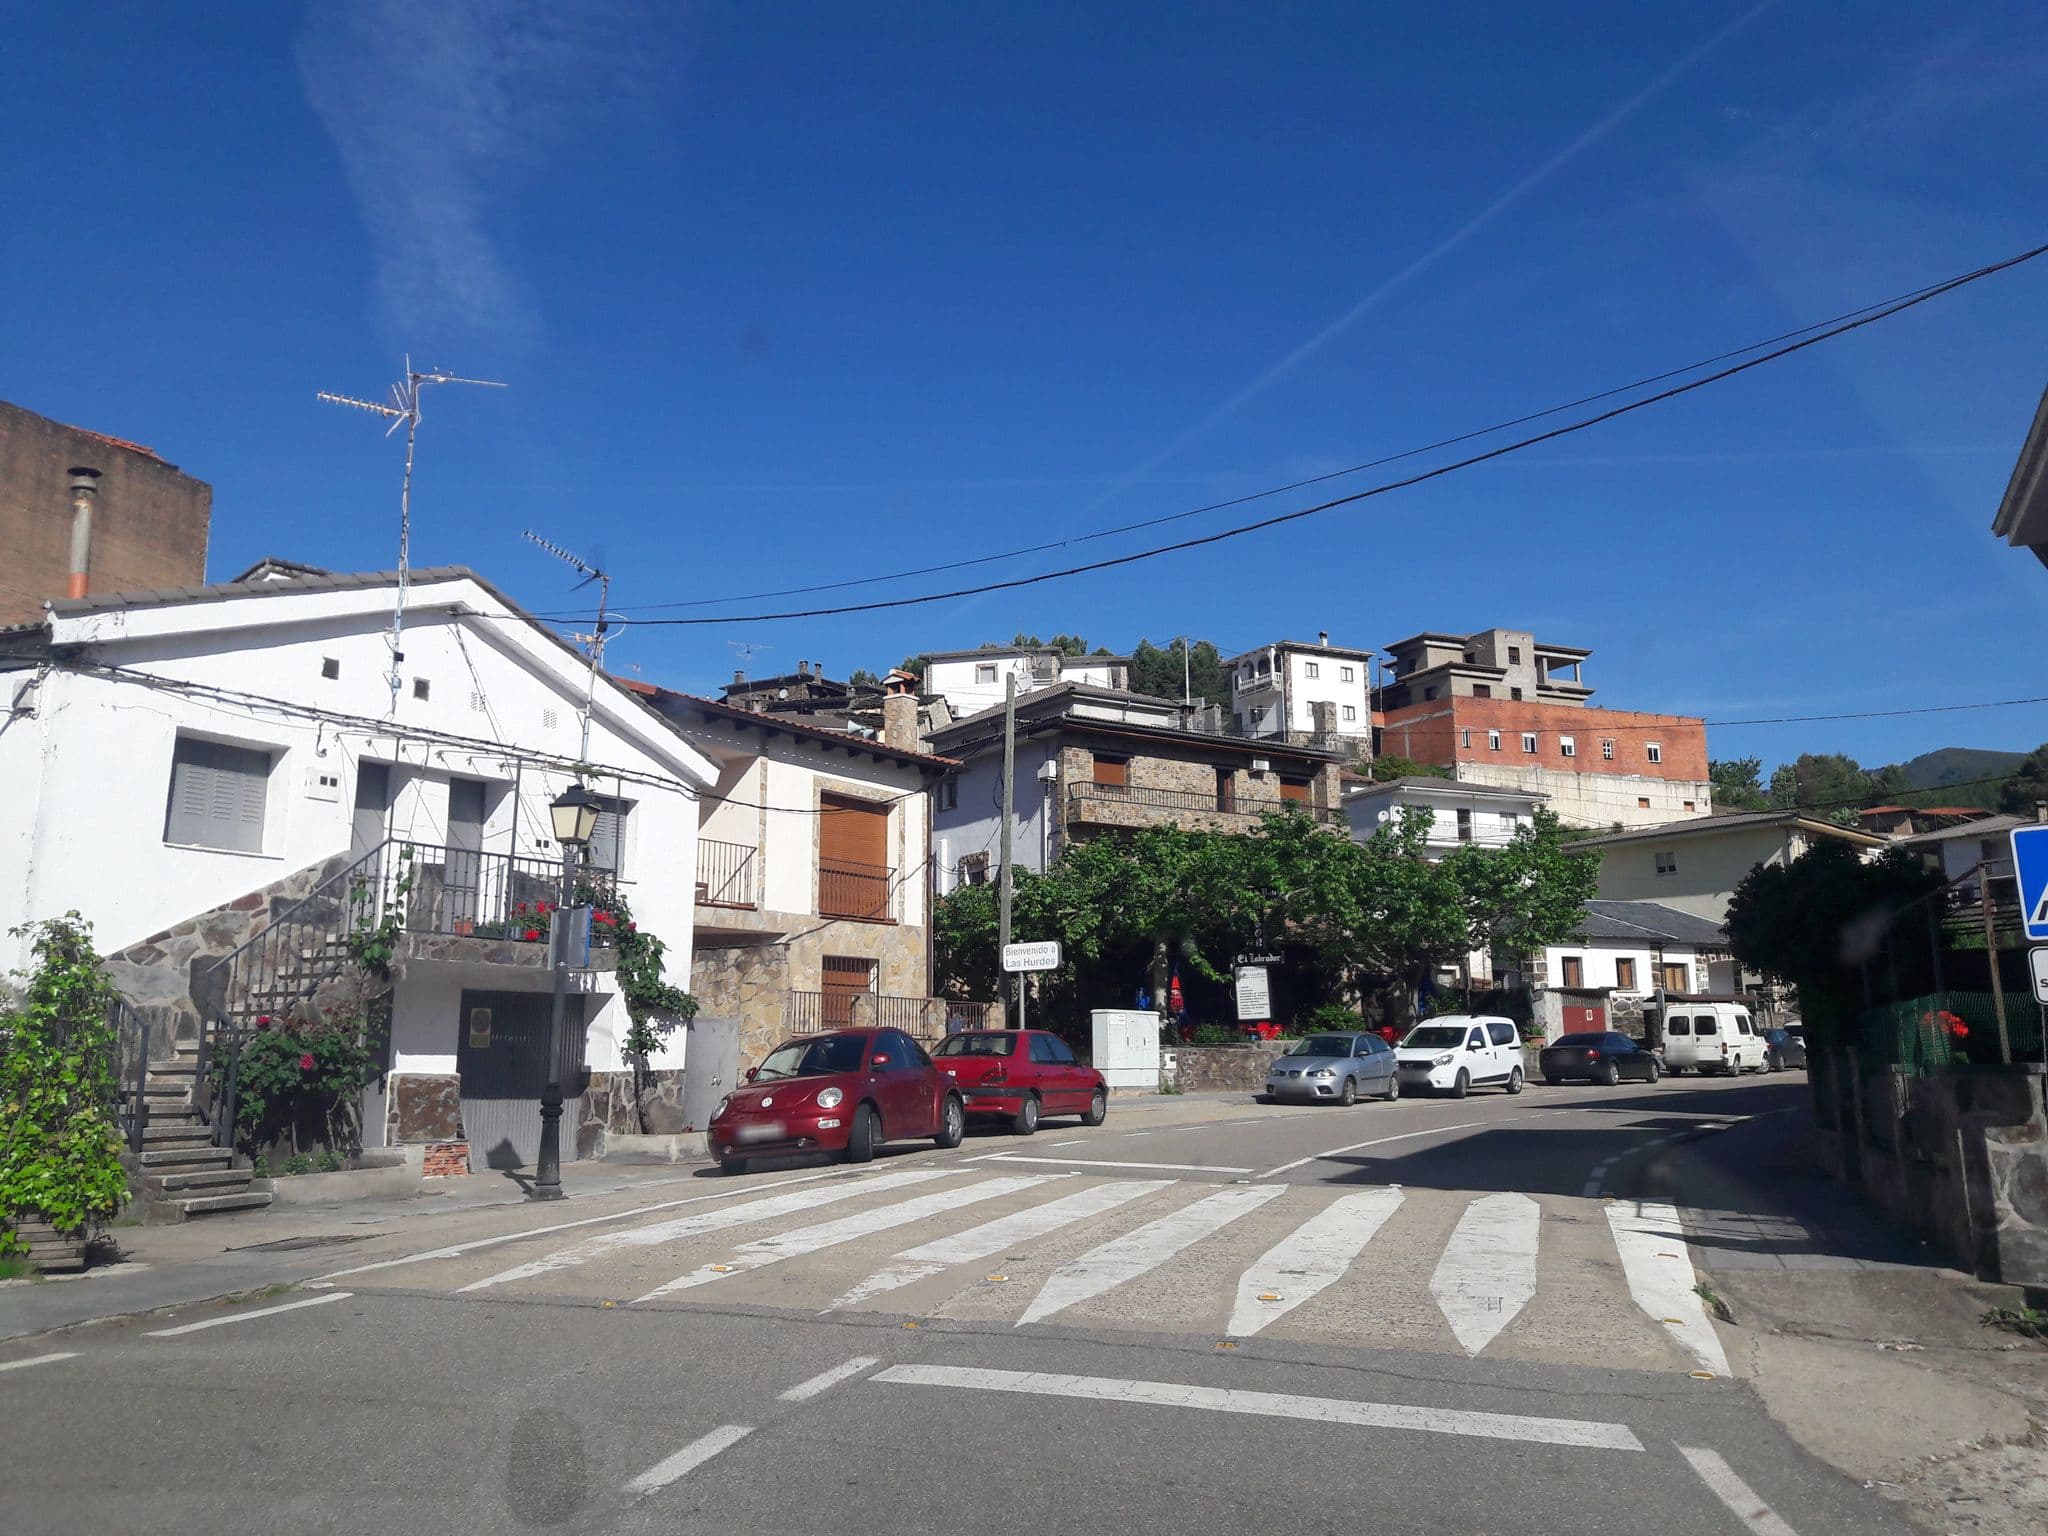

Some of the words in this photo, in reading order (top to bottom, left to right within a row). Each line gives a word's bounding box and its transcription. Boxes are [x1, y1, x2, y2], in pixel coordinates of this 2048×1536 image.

[1005, 945, 1048, 956] Bienvenido
[1005, 959, 1022, 968] Las
[1023, 957, 1056, 967] Hurdes
[1237, 953, 1248, 963] El
[1248, 952, 1281, 963] Labrador
